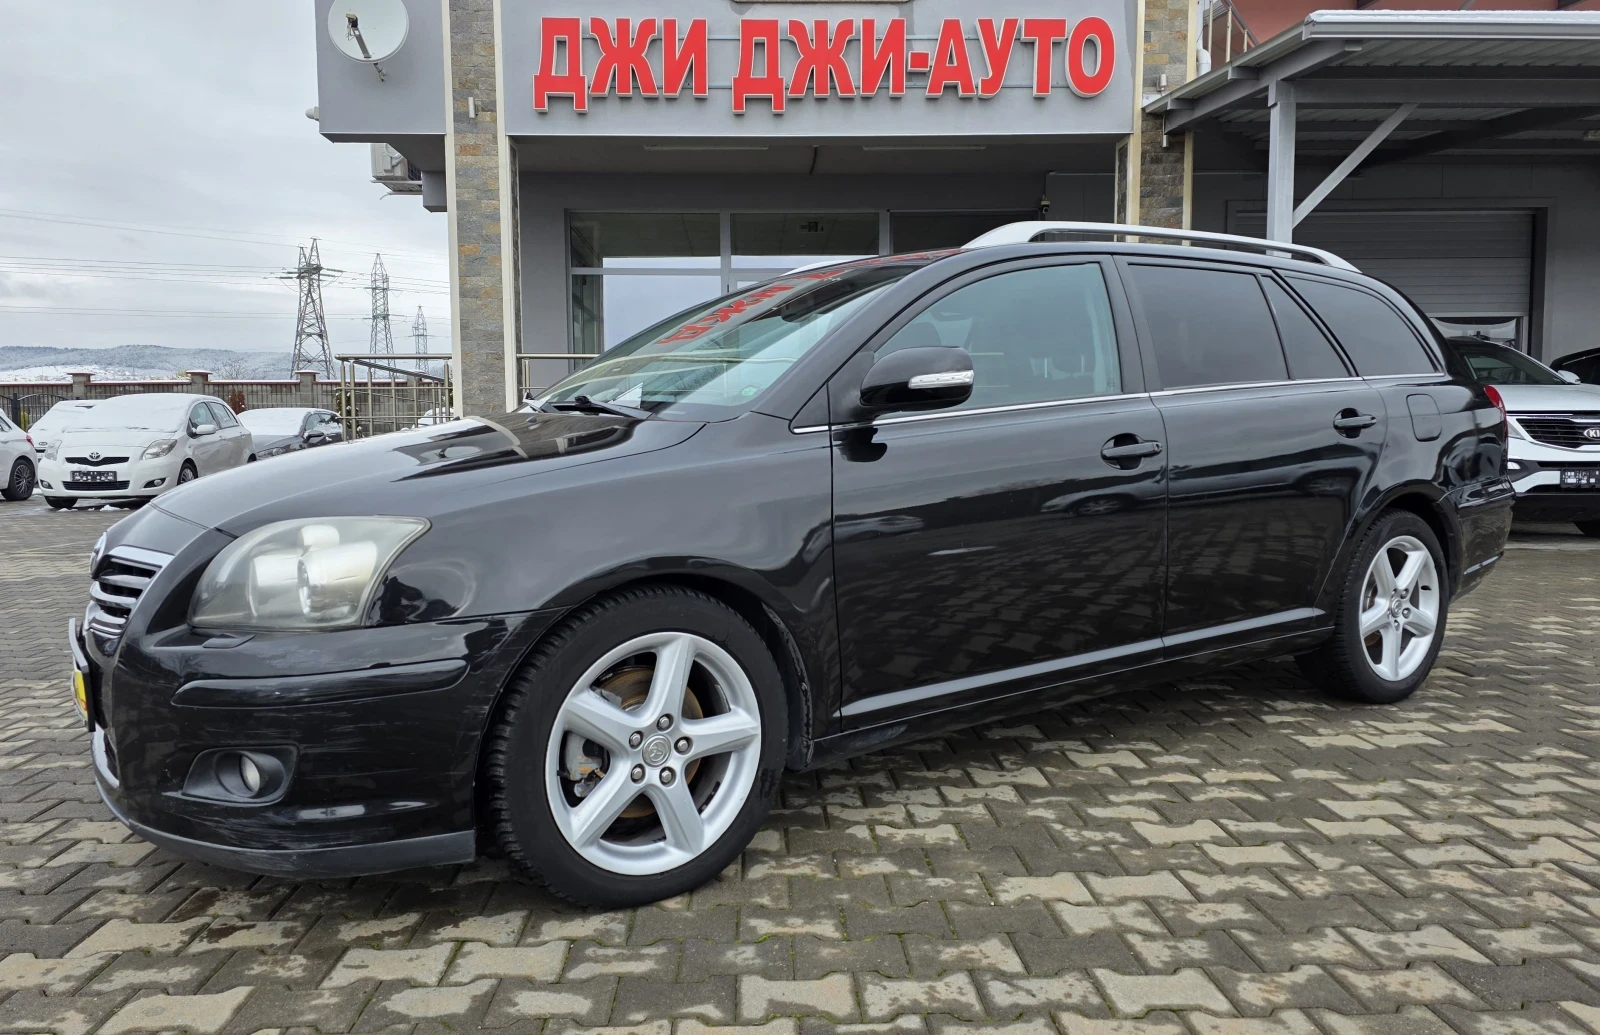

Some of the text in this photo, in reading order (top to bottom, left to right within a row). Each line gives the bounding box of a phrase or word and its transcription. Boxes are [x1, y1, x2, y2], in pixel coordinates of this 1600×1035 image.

[533, 17, 1116, 115] ДЖИ ДЖИ-АУТО
[1589, 430, 1600, 438] KI
